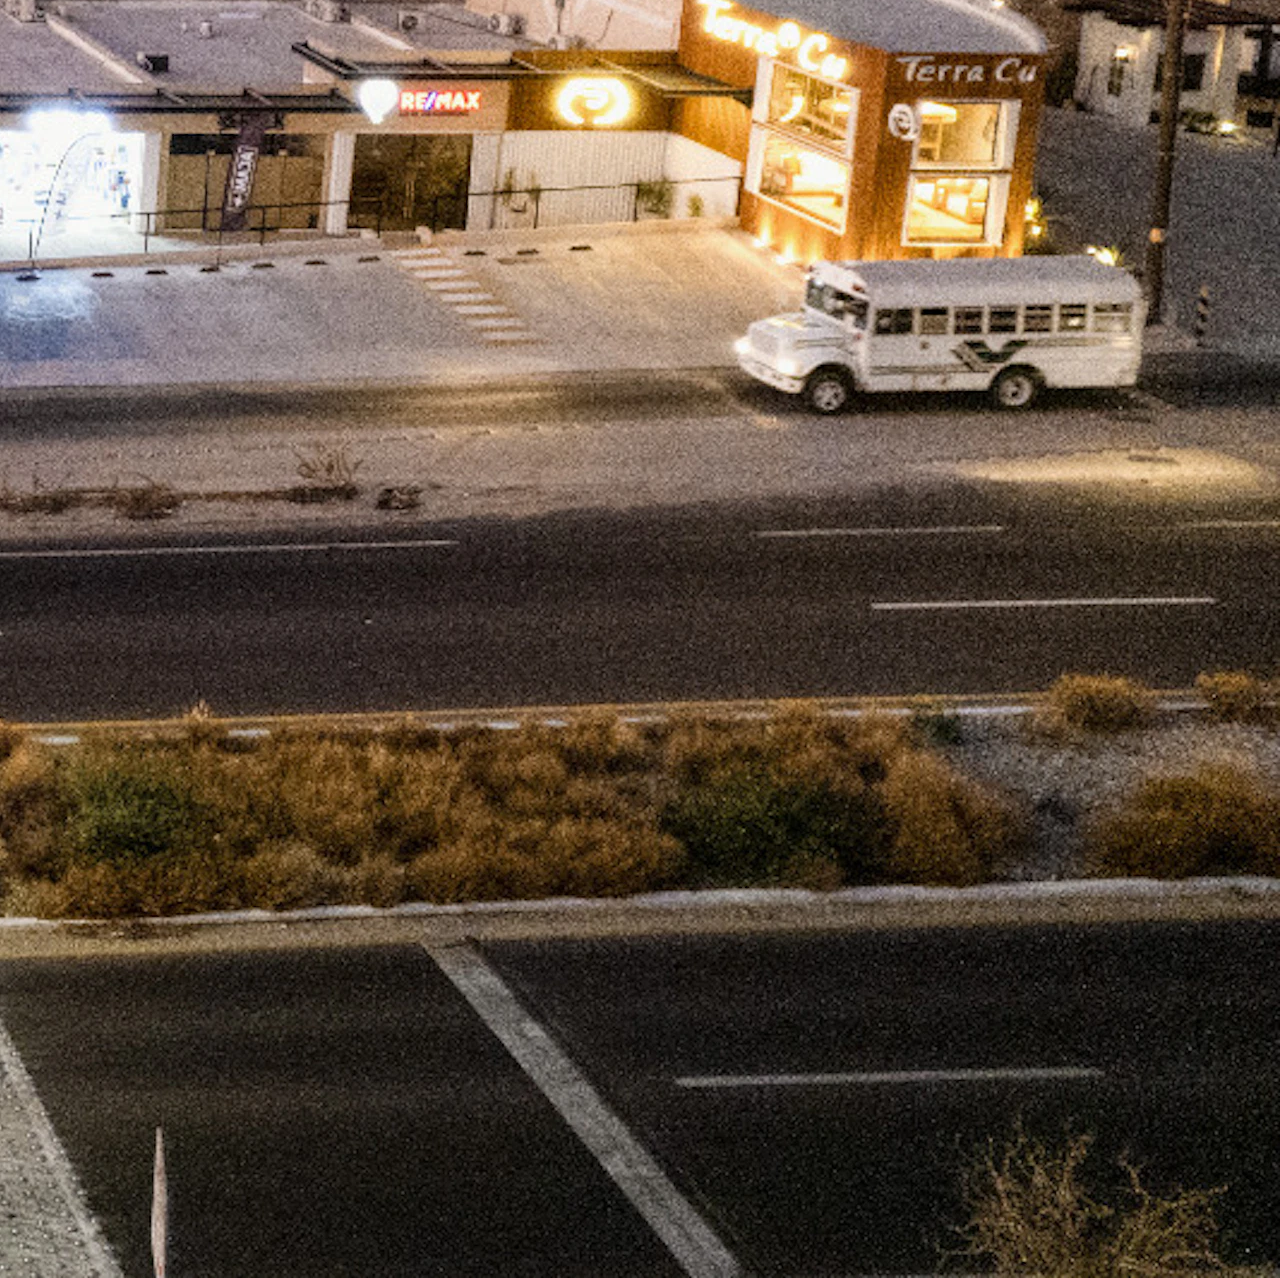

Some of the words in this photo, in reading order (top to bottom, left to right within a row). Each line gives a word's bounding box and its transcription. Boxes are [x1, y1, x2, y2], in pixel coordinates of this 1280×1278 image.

[798, 33, 848, 80] Cu
[895, 55, 985, 82] Terra
[994, 57, 1038, 83] Cu
[400, 91, 480, 111] RE/MAX
